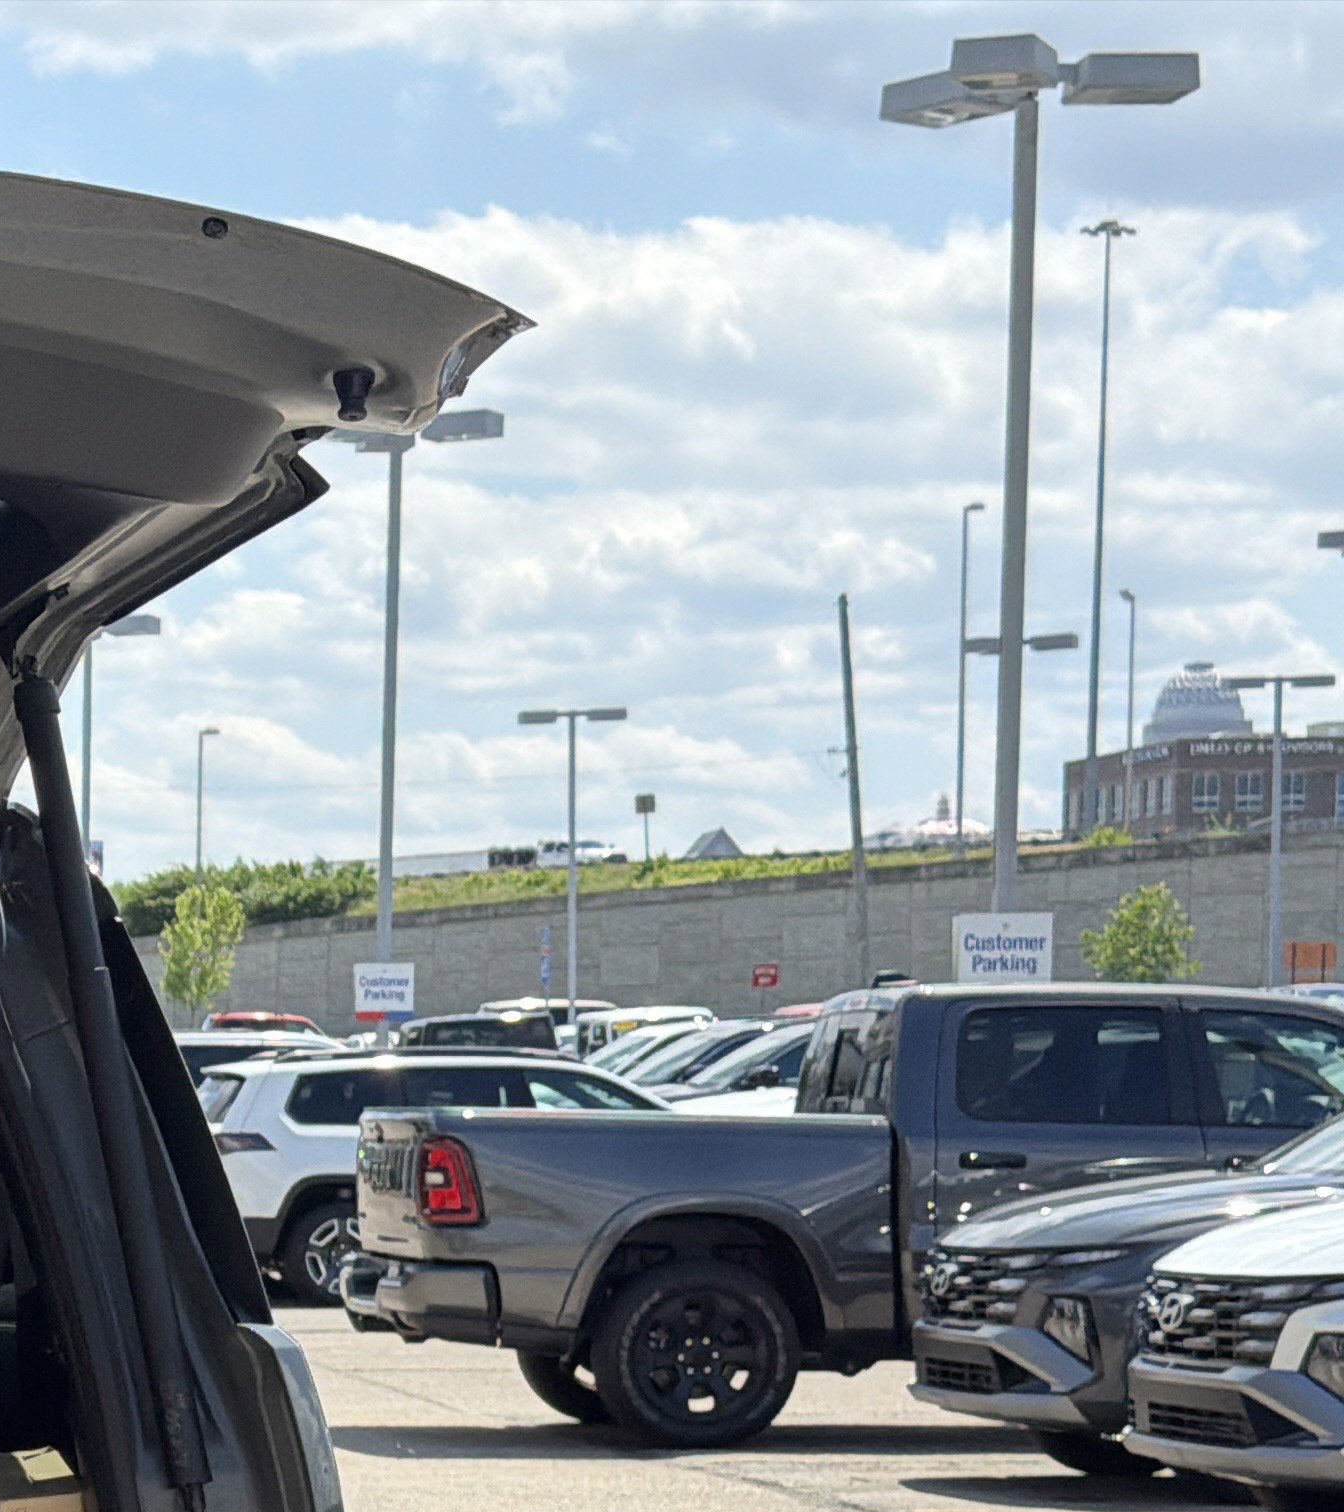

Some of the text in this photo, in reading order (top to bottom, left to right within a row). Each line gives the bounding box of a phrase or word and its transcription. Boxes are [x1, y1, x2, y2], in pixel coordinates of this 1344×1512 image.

[964, 933, 1046, 951] Customer
[972, 954, 1037, 976] Parking
[359, 975, 409, 988] Customer
[364, 988, 405, 1003] Parking
